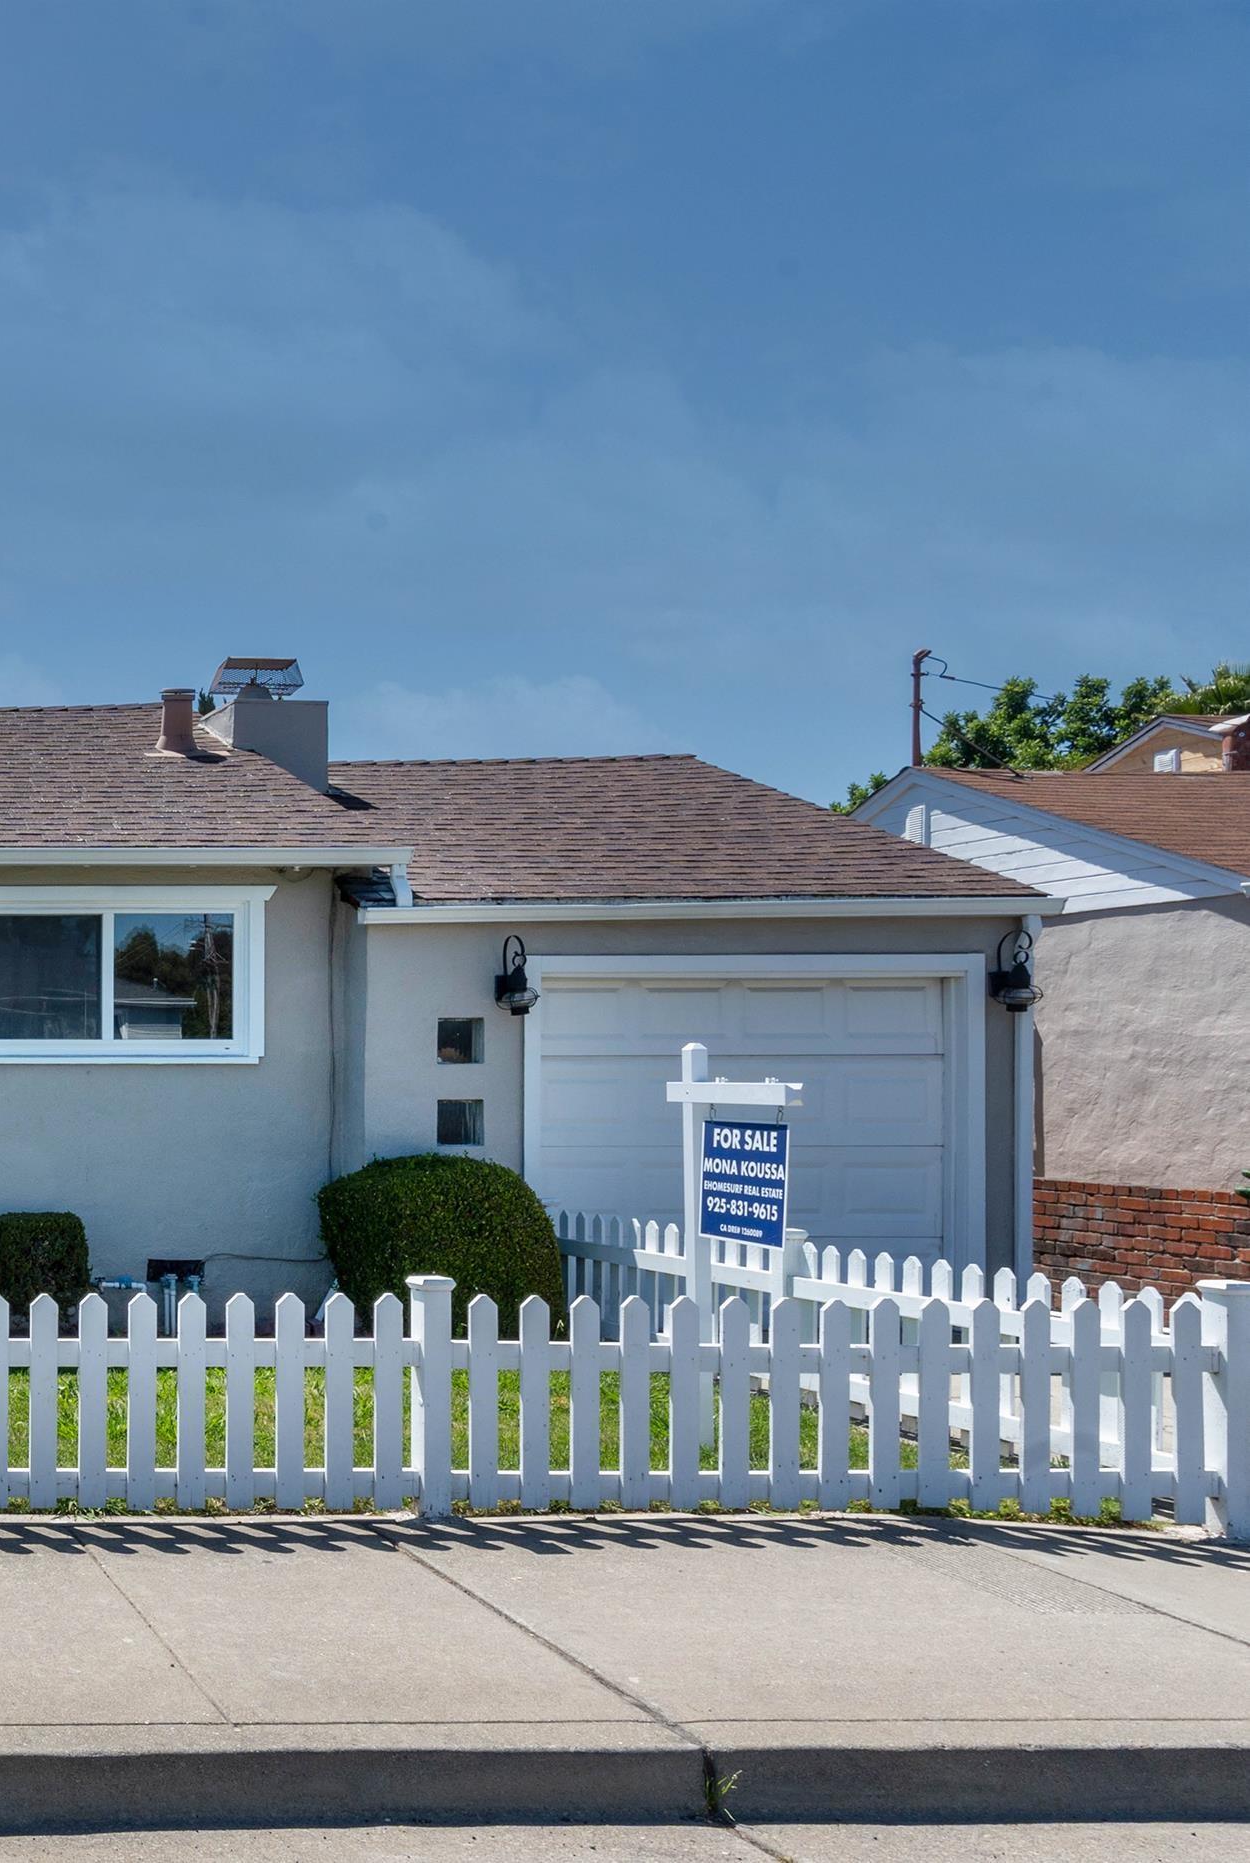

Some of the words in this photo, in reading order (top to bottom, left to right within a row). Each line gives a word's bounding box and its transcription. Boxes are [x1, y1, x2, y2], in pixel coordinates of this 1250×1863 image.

[713, 1128, 741, 1149] FOR
[744, 1129, 778, 1152] SALE
[703, 1157, 738, 1175] MONA
[741, 1161, 785, 1181] KOUSSA
[703, 1180, 743, 1194] EHOMESURF
[744, 1184, 760, 1196] REAL
[761, 1187, 783, 1199] ESTATE
[706, 1196, 778, 1221] 925-831-9615
[720, 1224, 727, 1232] CA
